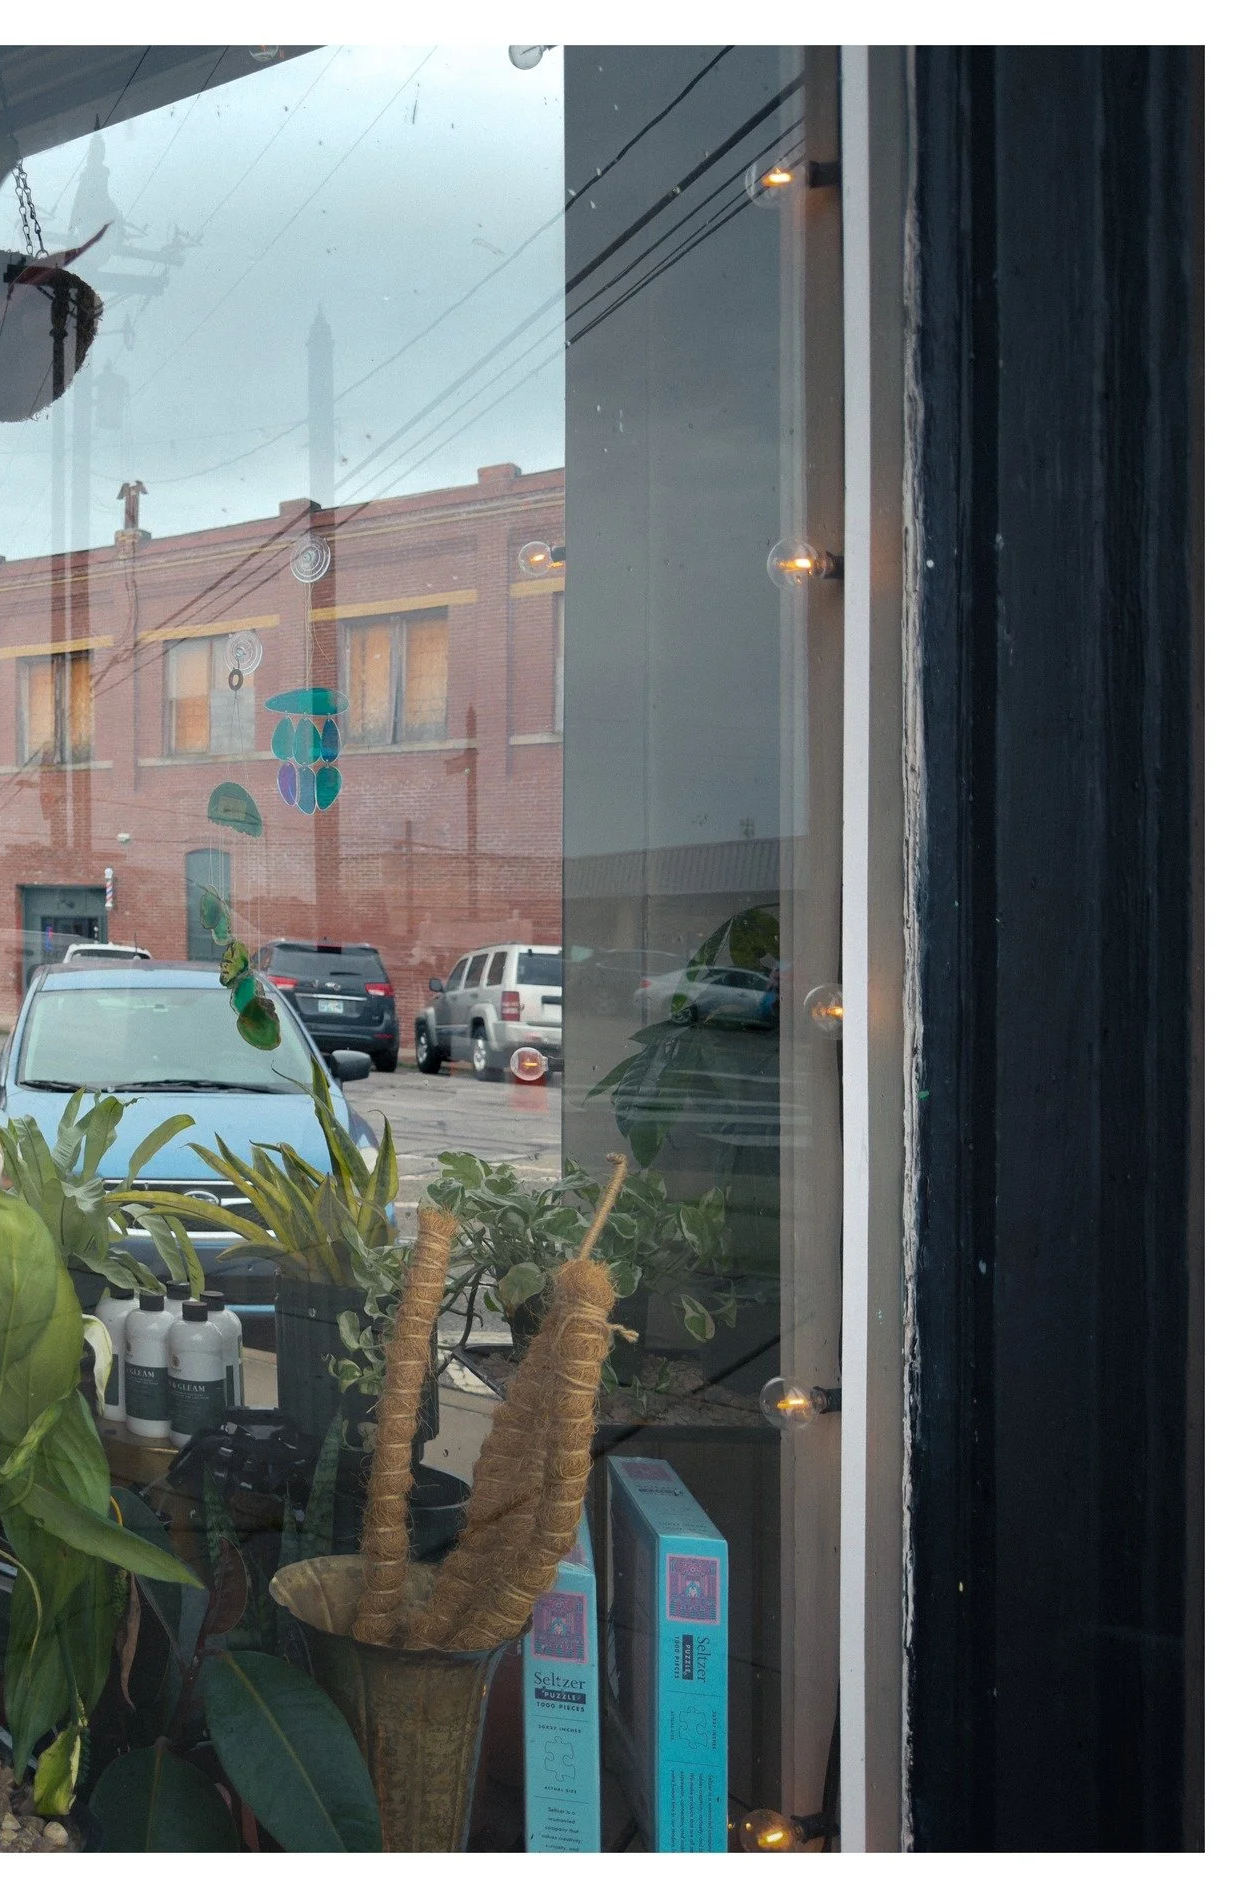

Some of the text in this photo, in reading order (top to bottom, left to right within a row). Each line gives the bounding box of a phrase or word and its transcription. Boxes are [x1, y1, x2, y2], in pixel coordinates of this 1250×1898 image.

[177, 1383, 206, 1392] GLEAM
[696, 1636, 711, 1684] Seltzer
[534, 1671, 586, 1690] Seltzer
[544, 1692, 576, 1701] PUZZLE
[536, 1701, 585, 1712] 1000 PIECES
